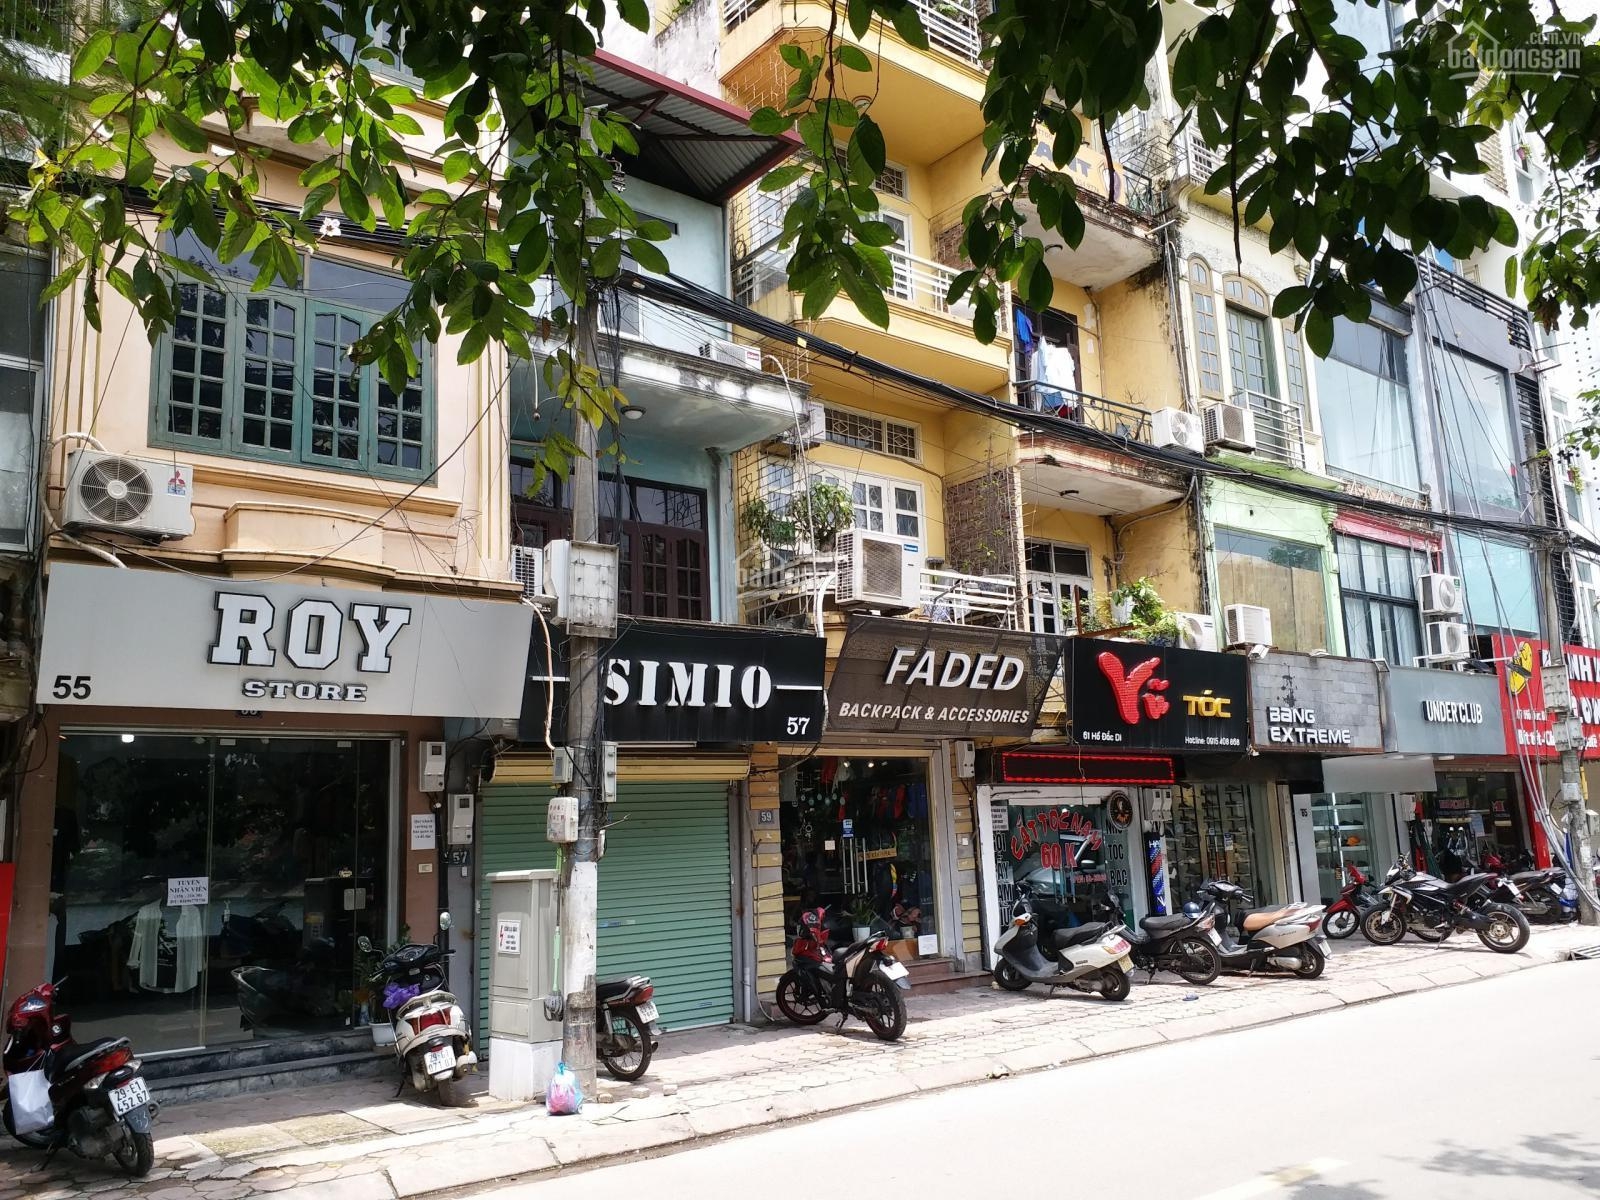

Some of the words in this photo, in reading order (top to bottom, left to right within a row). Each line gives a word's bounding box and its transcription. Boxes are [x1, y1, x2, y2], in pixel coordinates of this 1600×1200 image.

[207, 591, 411, 673] ROY
[884, 648, 1025, 691] FADED
[52, 675, 92, 700] 55
[242, 679, 367, 701] STORE
[604, 658, 772, 709] SIMIO
[839, 702, 923, 720] BACKPACK
[924, 706, 935, 720] &
[937, 707, 1030, 724] ACCESSORIES
[786, 716, 810, 735] 57
[1269, 726, 1352, 744] EXTREME
[761, 811, 772, 822] 59
[452, 851, 467, 864] 57
[1041, 843, 1062, 869] 60
[115, 1081, 141, 1101] 29-E1
[117, 1090, 147, 1113] 452.67
